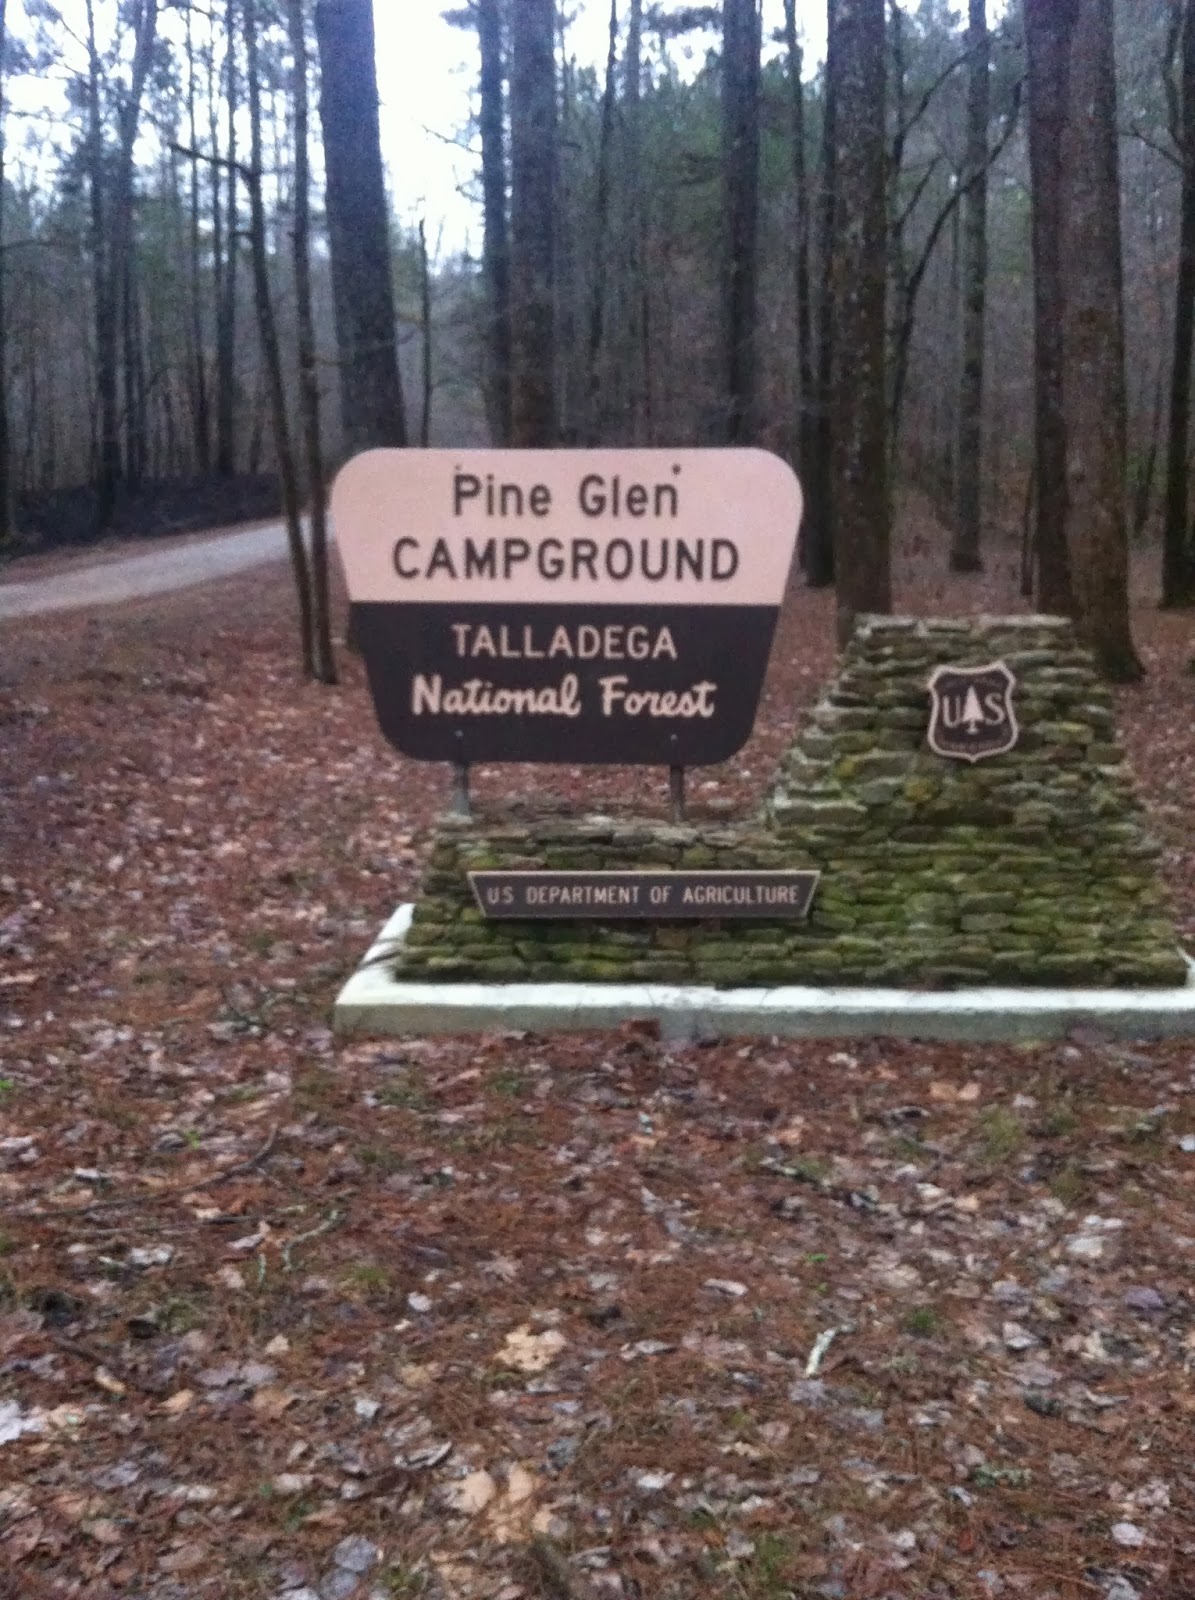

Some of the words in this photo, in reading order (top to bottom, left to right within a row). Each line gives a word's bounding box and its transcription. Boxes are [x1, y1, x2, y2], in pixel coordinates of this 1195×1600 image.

[453, 473, 552, 517] Pine
[578, 473, 679, 517] Glen
[392, 536, 740, 582] CAMPGROUND
[451, 623, 679, 660] TALLADEGA
[410, 673, 582, 718] National
[599, 676, 718, 719] Forest
[525, 885, 641, 905] DEPARTMENT
[649, 885, 673, 903] OF
[683, 884, 799, 905] AGRICULTURE
